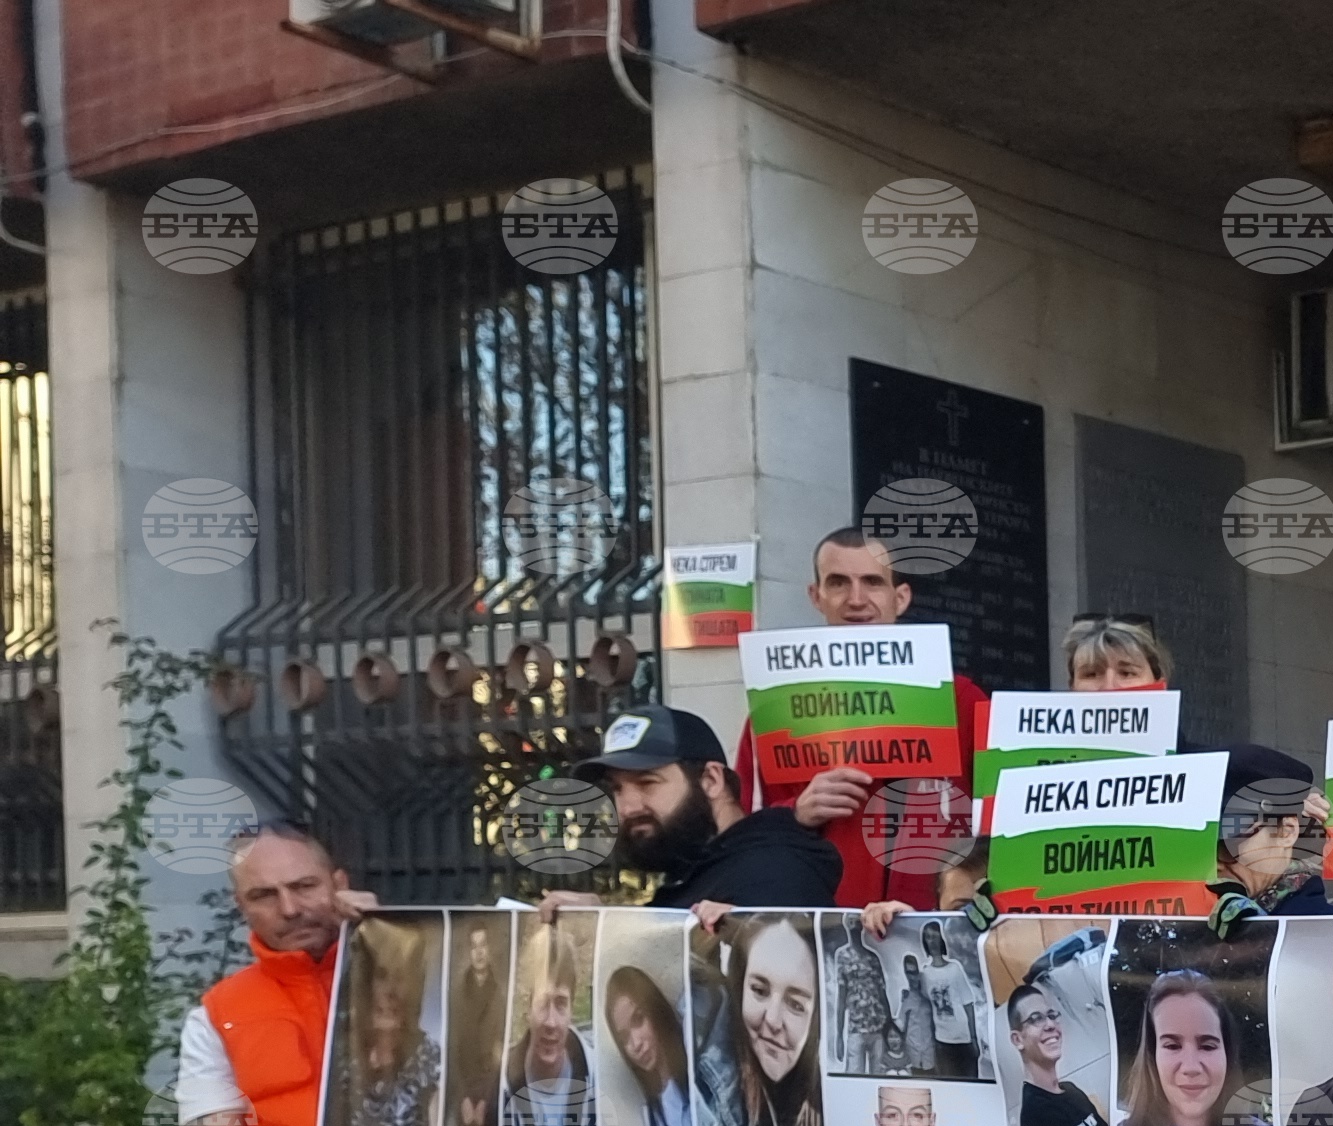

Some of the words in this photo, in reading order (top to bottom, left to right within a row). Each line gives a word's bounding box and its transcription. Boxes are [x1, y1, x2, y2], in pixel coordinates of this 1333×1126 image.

[766, 647, 823, 671] НЕКА
[829, 641, 914, 667] СПРЕМ
[791, 687, 895, 719] ВОЙНАТА
[1018, 707, 1076, 734] НЕКА
[1081, 707, 1149, 734] СПРЕМ
[773, 743, 800, 769] ПО
[803, 738, 933, 767] ПЪТИЩАТА
[1025, 780, 1089, 814] НЕКА
[1096, 773, 1186, 808] СПРЕМ
[1044, 834, 1155, 875] ВОЙНАТА
